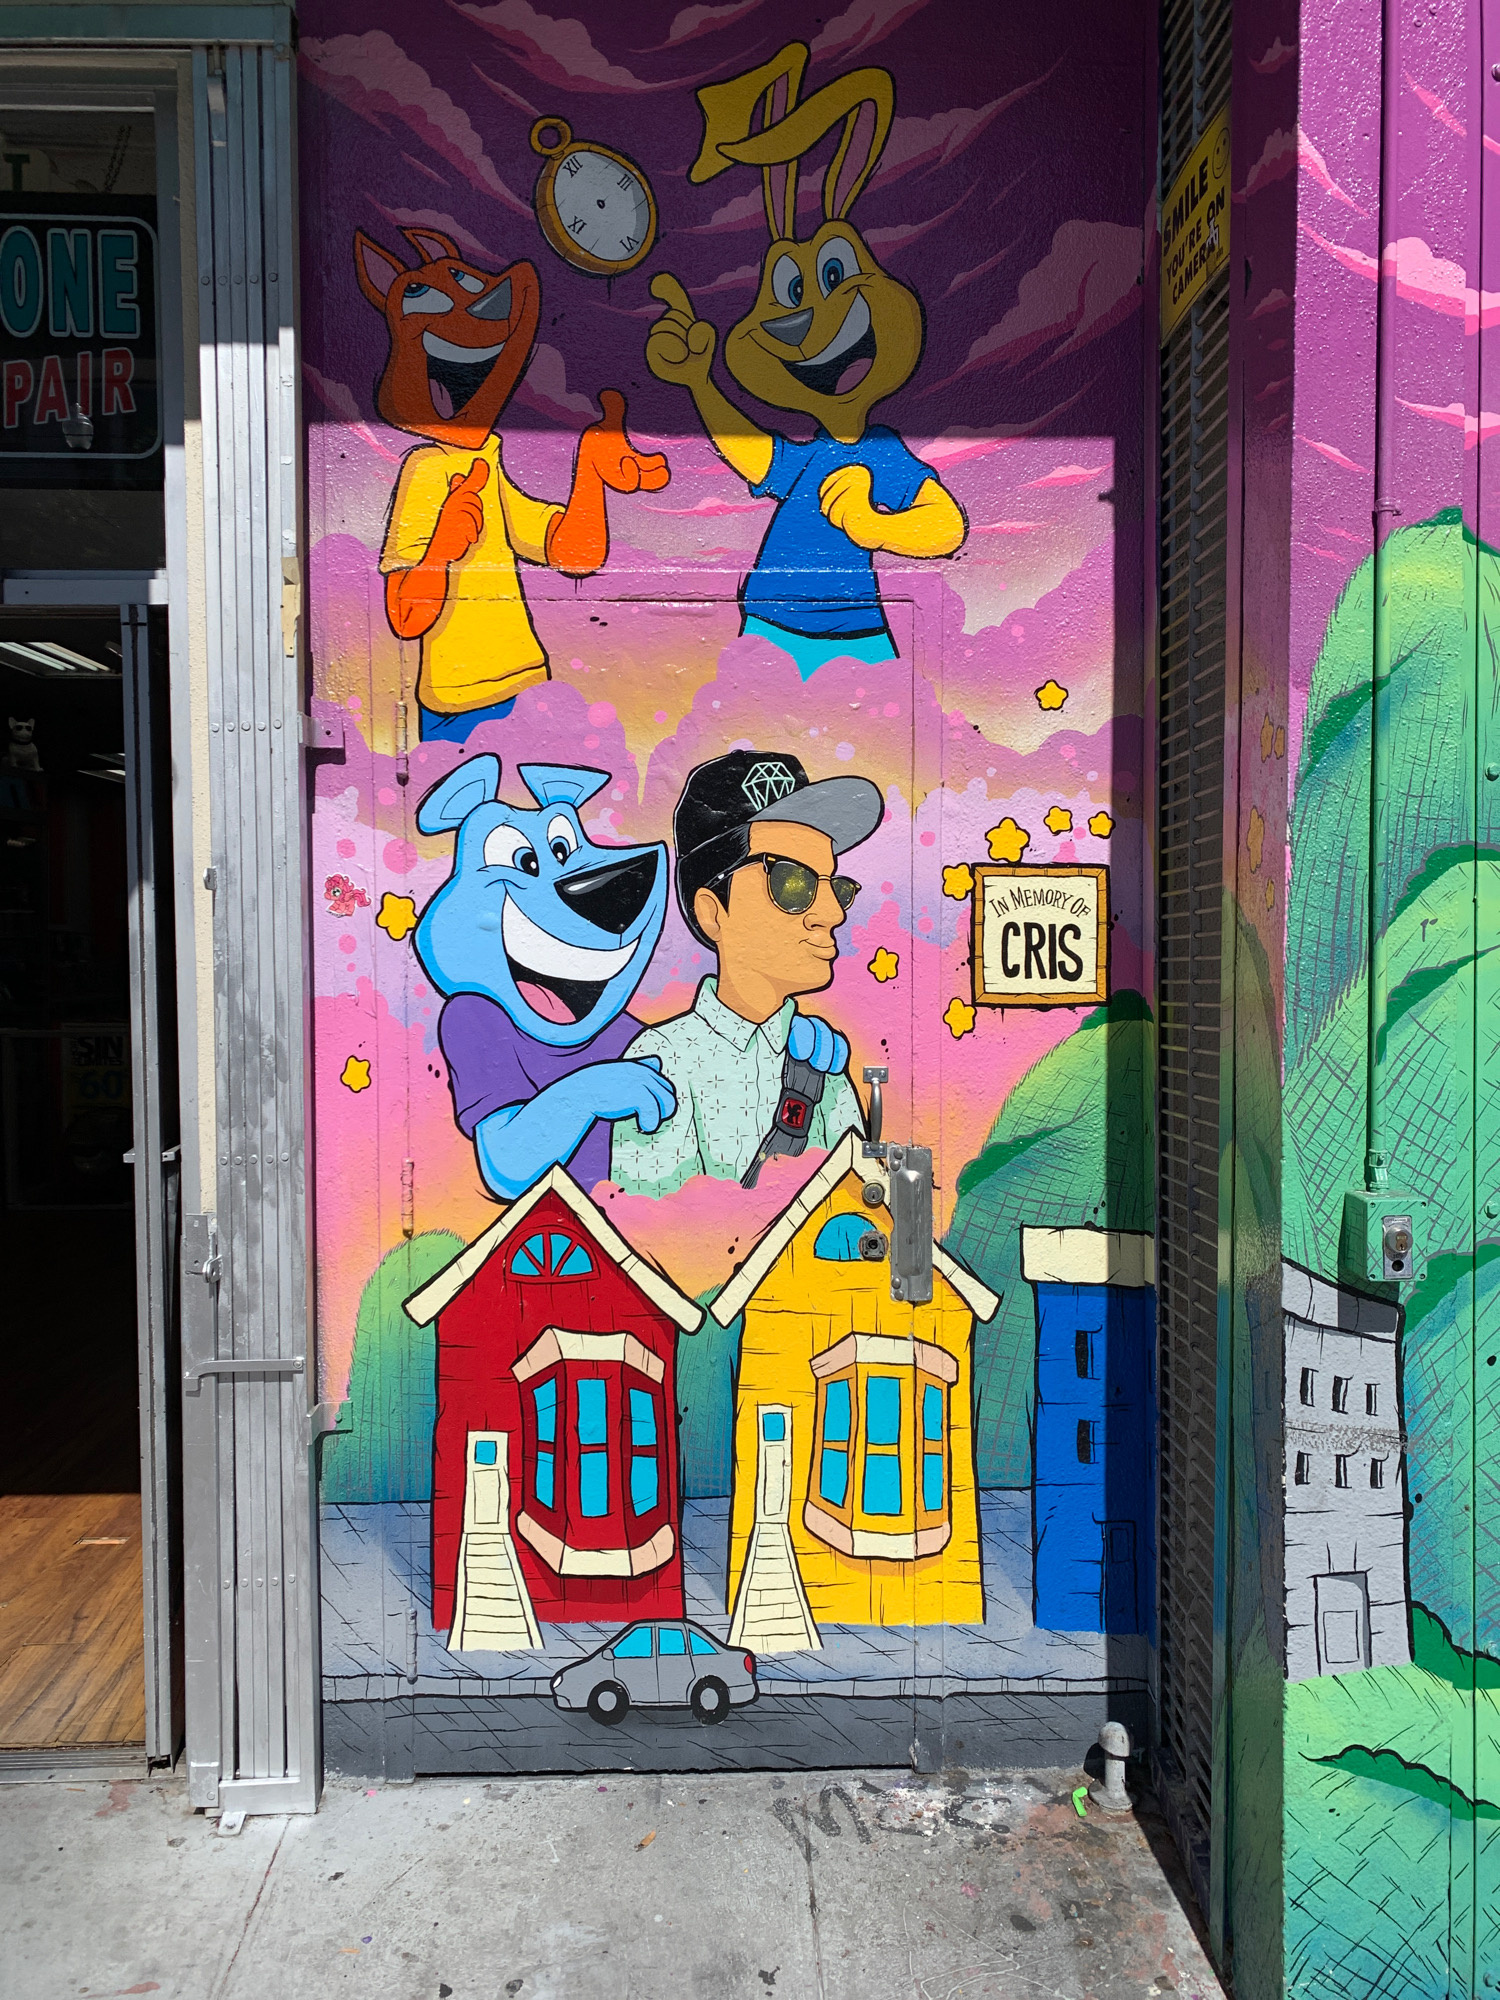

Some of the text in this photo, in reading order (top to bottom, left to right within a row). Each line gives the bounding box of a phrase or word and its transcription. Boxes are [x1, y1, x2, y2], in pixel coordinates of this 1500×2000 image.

[1163, 155, 1209, 257] SMILE
[1166, 185, 1225, 286] YOU'RE ON
[0, 225, 141, 339] ONE
[2, 346, 138, 431] PAIR
[989, 886, 1092, 918] IN MEMORY OF
[1001, 921, 1084, 982] CRIS
